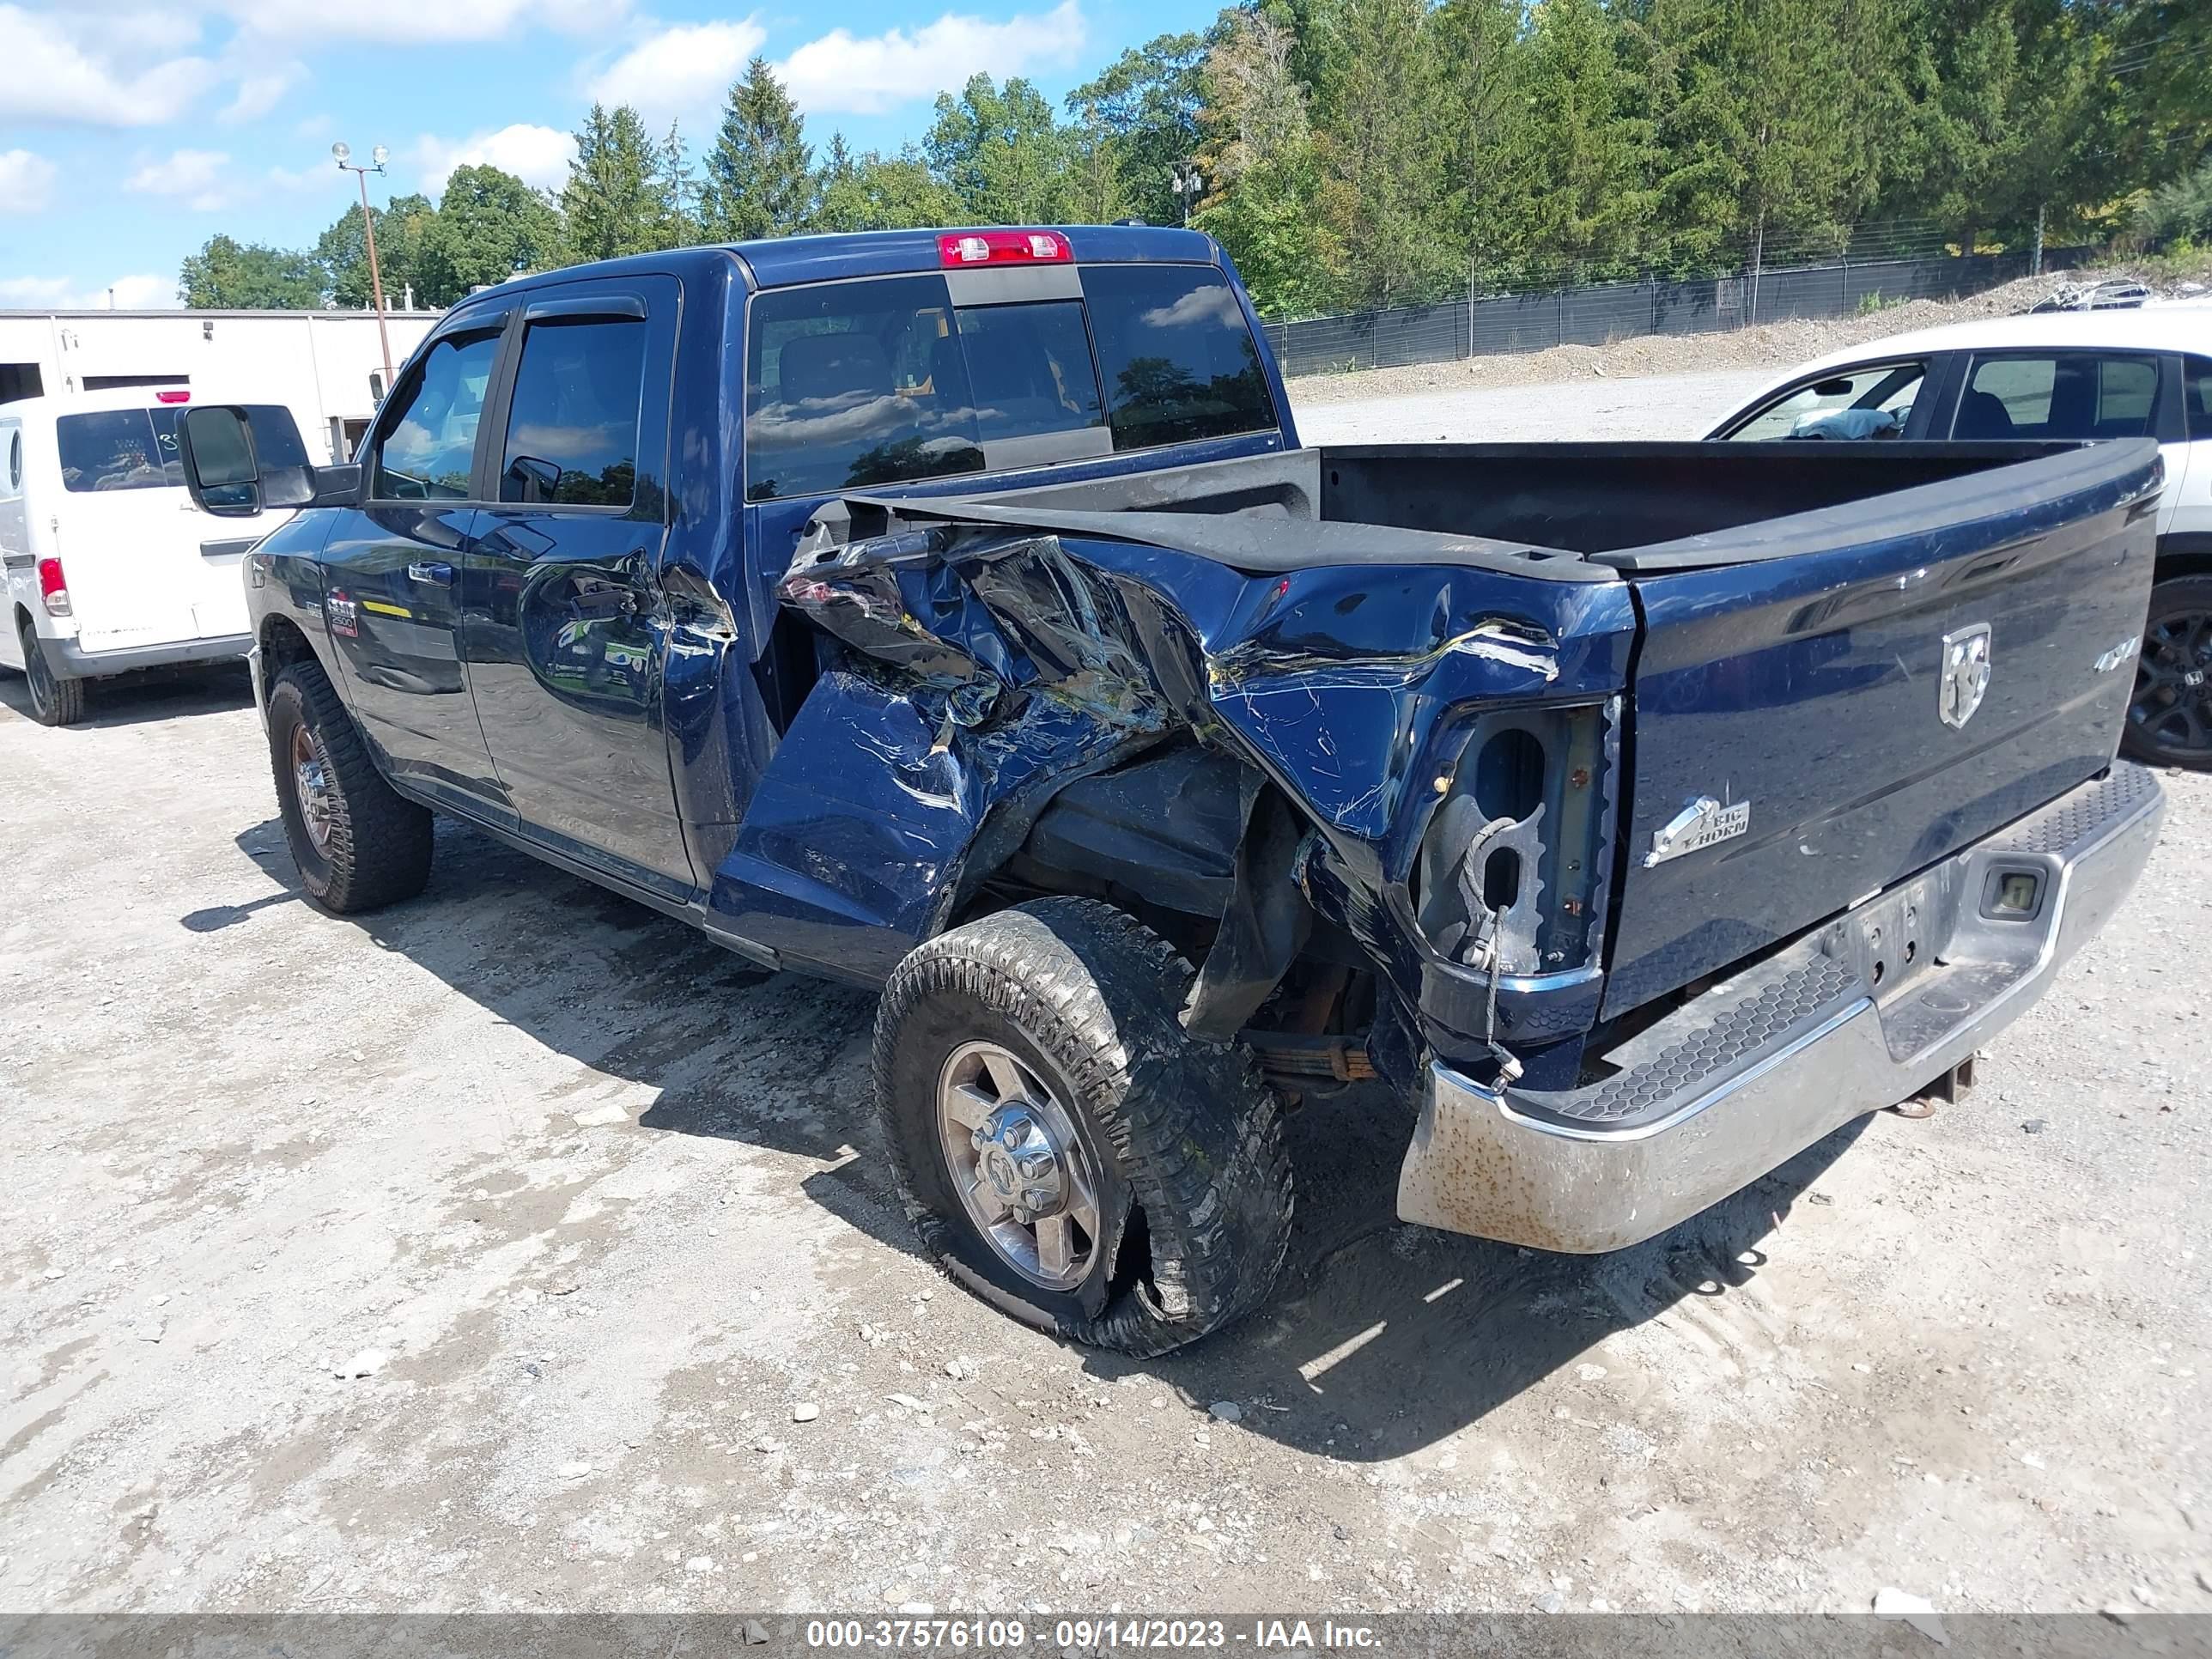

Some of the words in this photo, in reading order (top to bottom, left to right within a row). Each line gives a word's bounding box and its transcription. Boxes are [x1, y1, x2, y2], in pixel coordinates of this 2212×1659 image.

[331, 615, 354, 628] 2500
[1714, 809, 1742, 828] BIG
[1698, 820, 1747, 846] HORN
